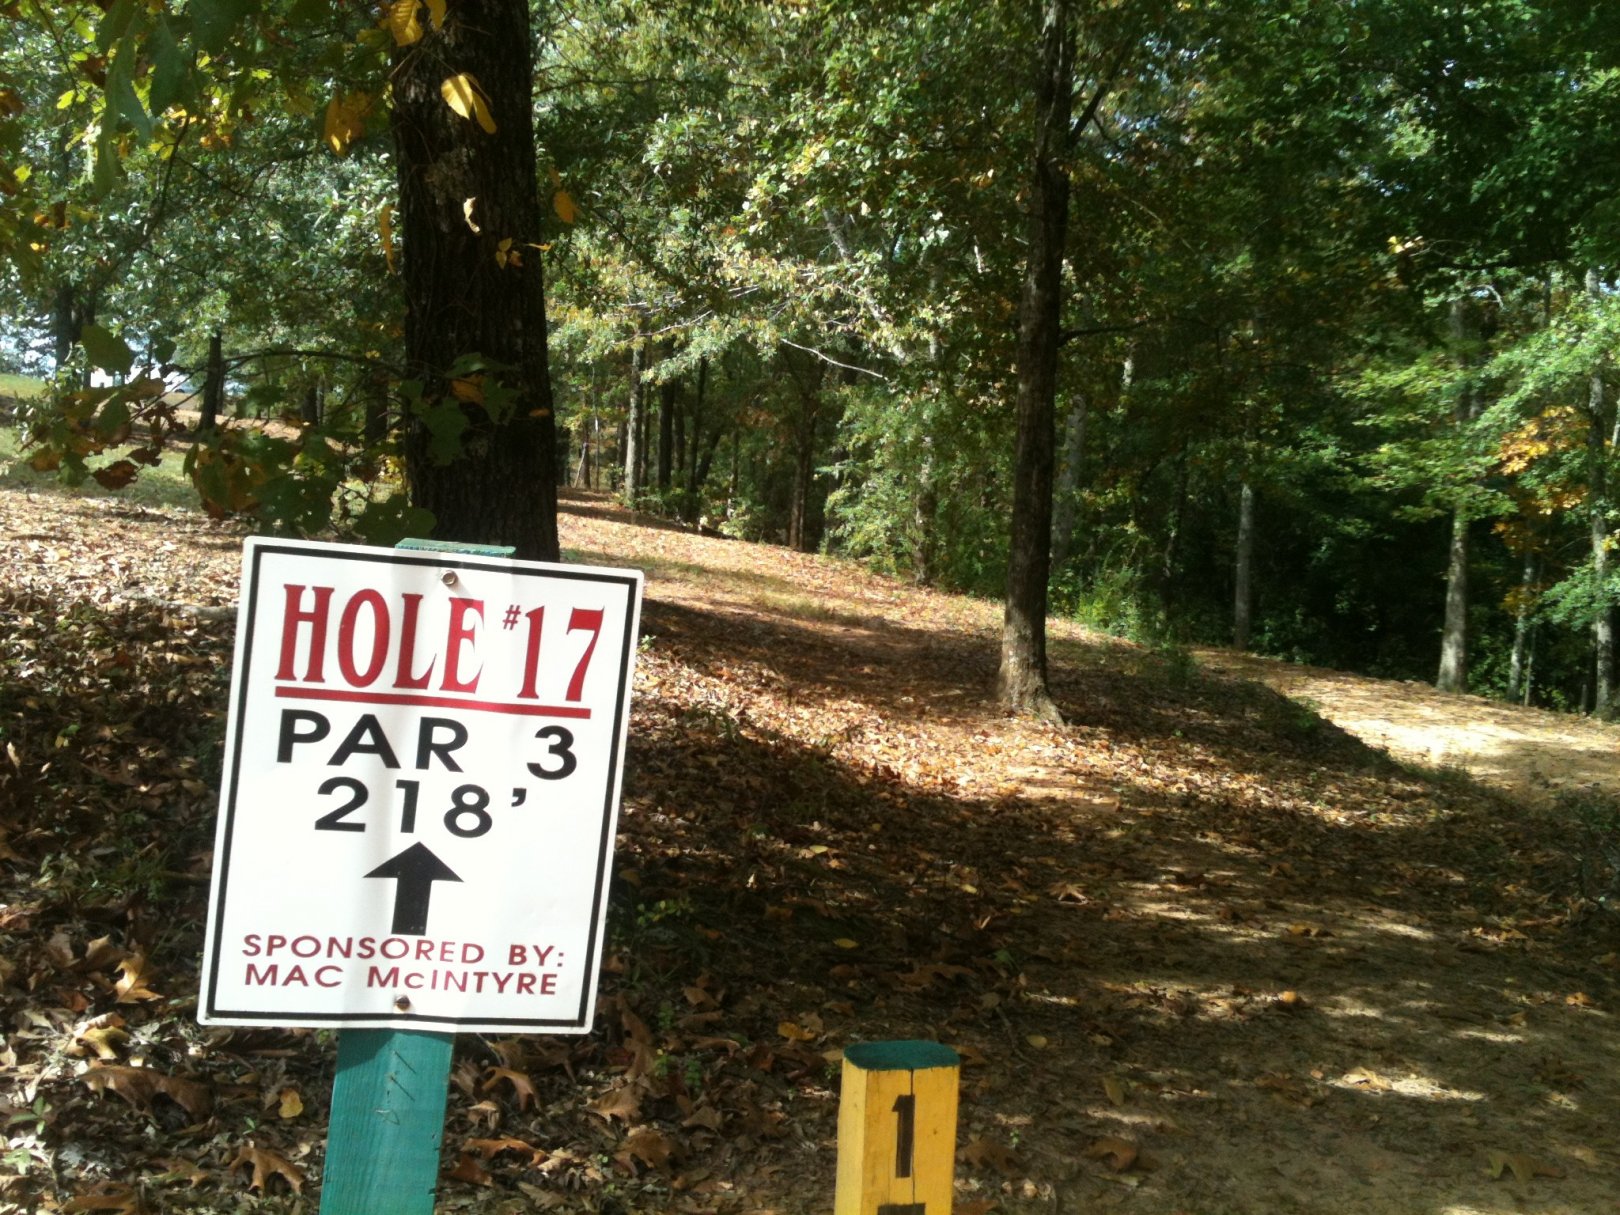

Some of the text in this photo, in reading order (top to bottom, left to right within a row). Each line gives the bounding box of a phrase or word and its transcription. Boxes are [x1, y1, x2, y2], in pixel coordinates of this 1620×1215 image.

[274, 583, 485, 694] HOLE
[276, 708, 578, 781] PAR 3
[314, 776, 527, 838] 218'
[242, 934, 566, 967] SPONSORED BY:
[244, 964, 559, 996] MAC McINTYRE
[892, 1094, 916, 1179] 1
